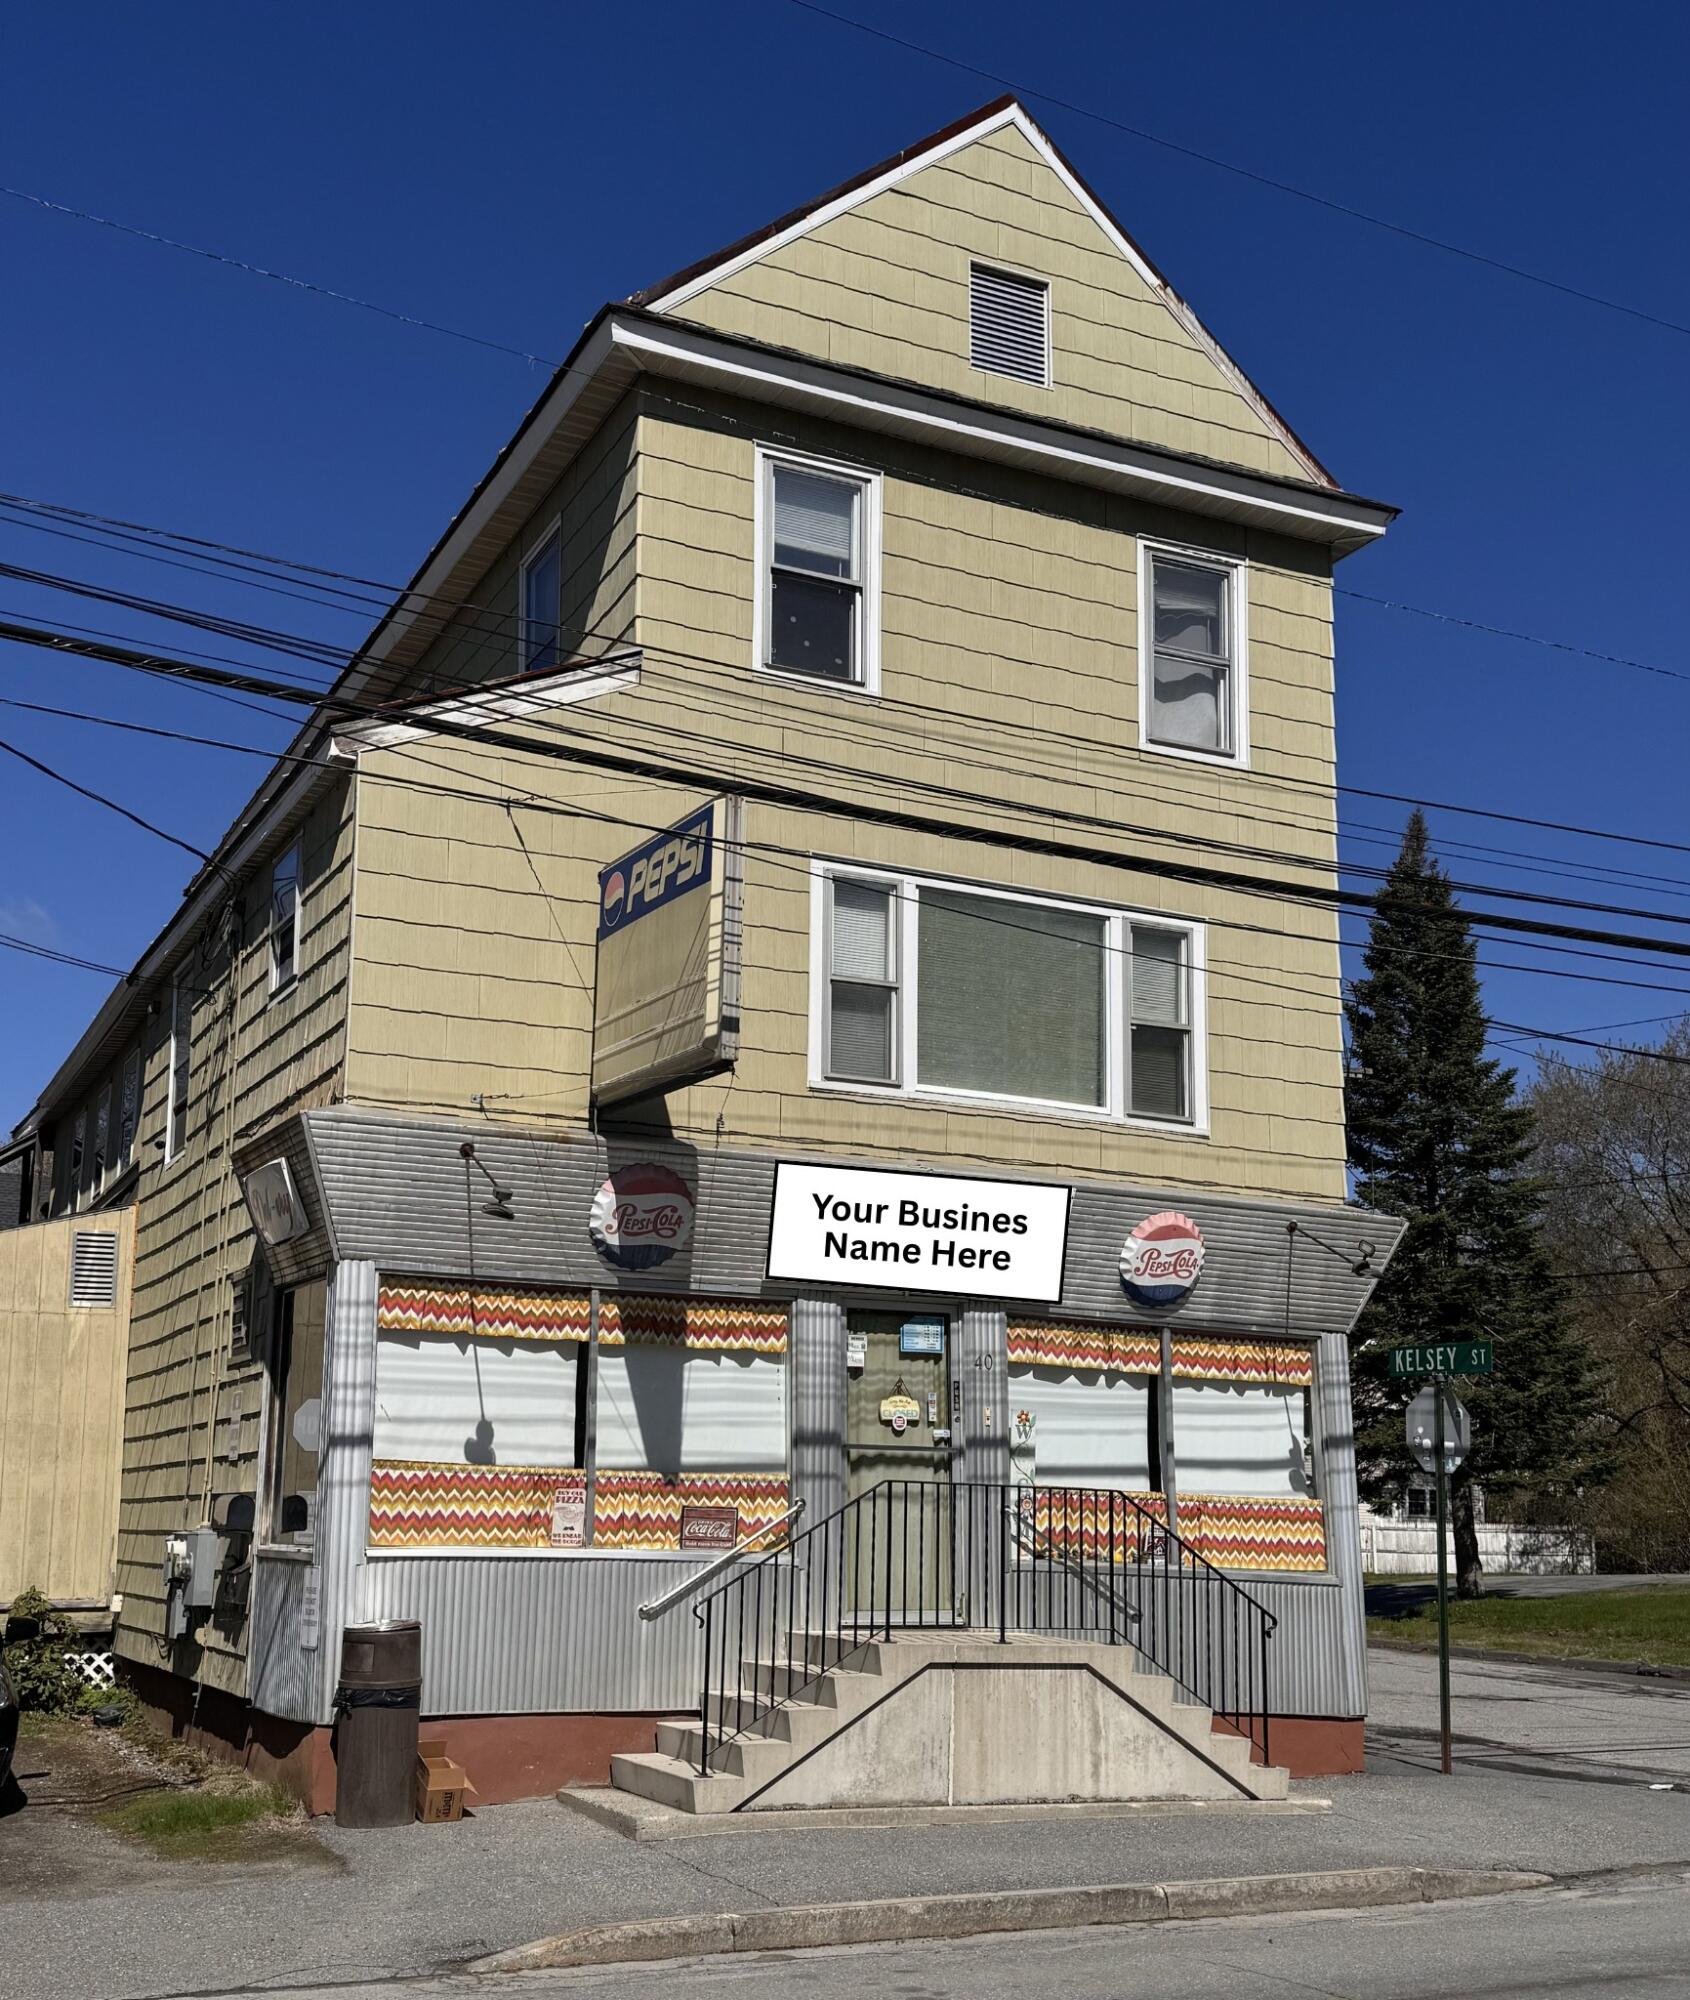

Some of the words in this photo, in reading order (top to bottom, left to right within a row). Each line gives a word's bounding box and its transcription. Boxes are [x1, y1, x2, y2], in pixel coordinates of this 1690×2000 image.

[626, 820, 708, 914] PEPSI
[812, 1193, 889, 1225] Your
[898, 1199, 1028, 1235] Busines
[824, 1231, 921, 1264] Name
[931, 1239, 1011, 1271] Here
[974, 1353, 993, 1371] 40
[1395, 1347, 1456, 1372] KELSEY
[1471, 1349, 1486, 1365] ST
[882, 1409, 919, 1418] CLOSED
[555, 1496, 584, 1504] PIZZA
